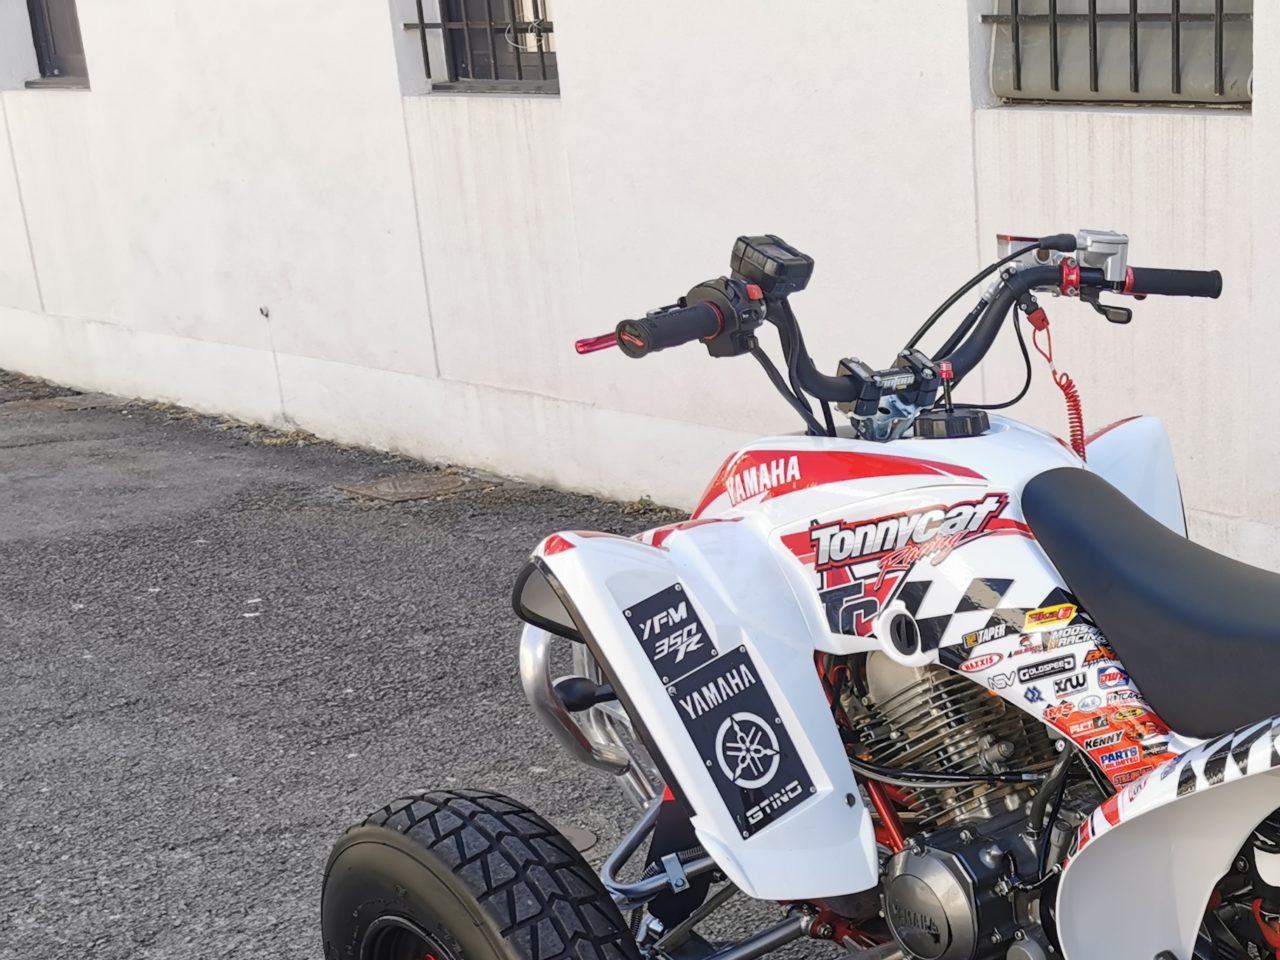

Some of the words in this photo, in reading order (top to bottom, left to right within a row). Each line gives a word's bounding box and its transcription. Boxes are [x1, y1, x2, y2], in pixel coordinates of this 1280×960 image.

[725, 456, 800, 507] YAMAHA
[638, 600, 688, 641] YFM
[977, 623, 1006, 645] TAPER
[653, 622, 705, 664] 350R
[678, 663, 756, 721] YAMAHA
[1085, 731, 1122, 750] KENNY
[1100, 746, 1138, 764] PARTS
